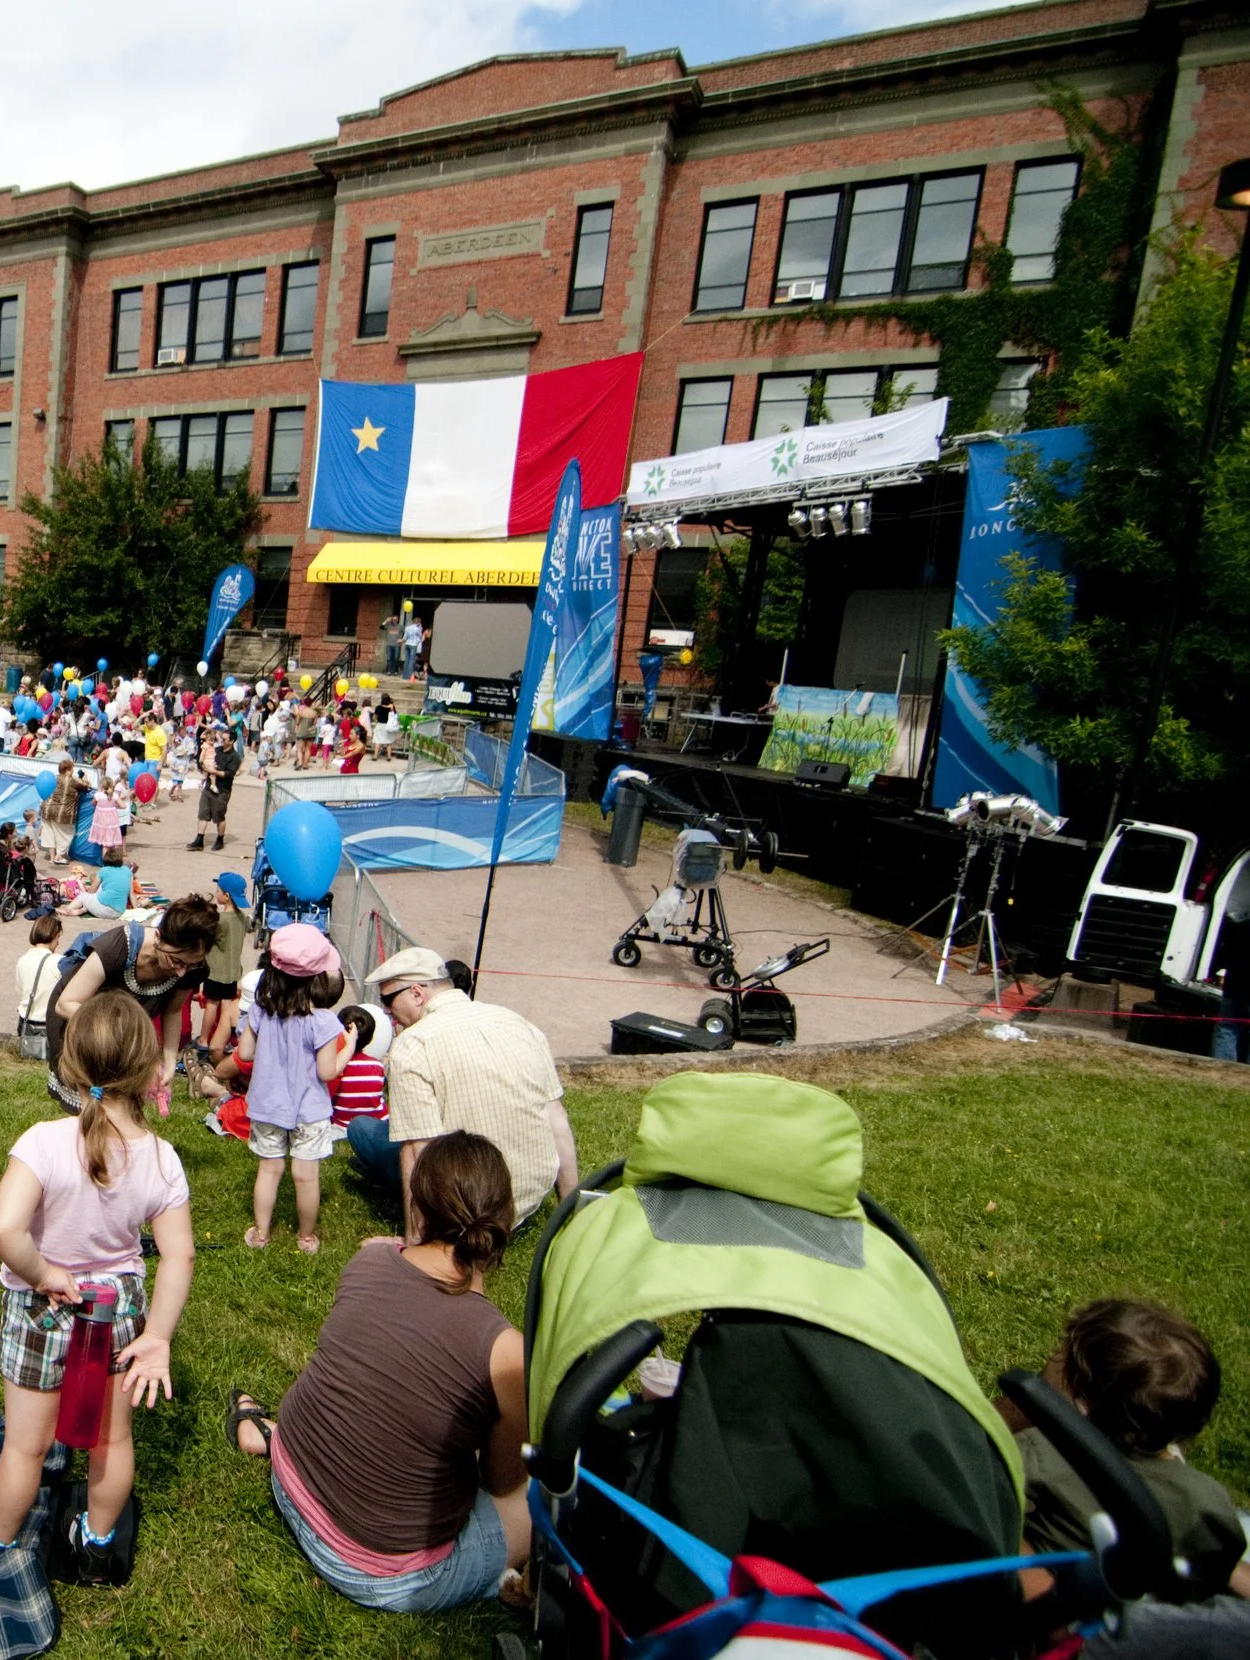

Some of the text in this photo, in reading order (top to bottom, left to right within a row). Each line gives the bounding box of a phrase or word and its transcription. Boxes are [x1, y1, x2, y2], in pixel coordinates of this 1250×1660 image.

[426, 230, 534, 258] ABERDEEN
[806, 439, 838, 453] Caisse
[802, 448, 858, 465] Beauséjour
[670, 467, 692, 478] Caisse
[315, 568, 541, 585] CENTRE CULTUREL ABERDEE
[571, 578, 613, 593] DIRECT
